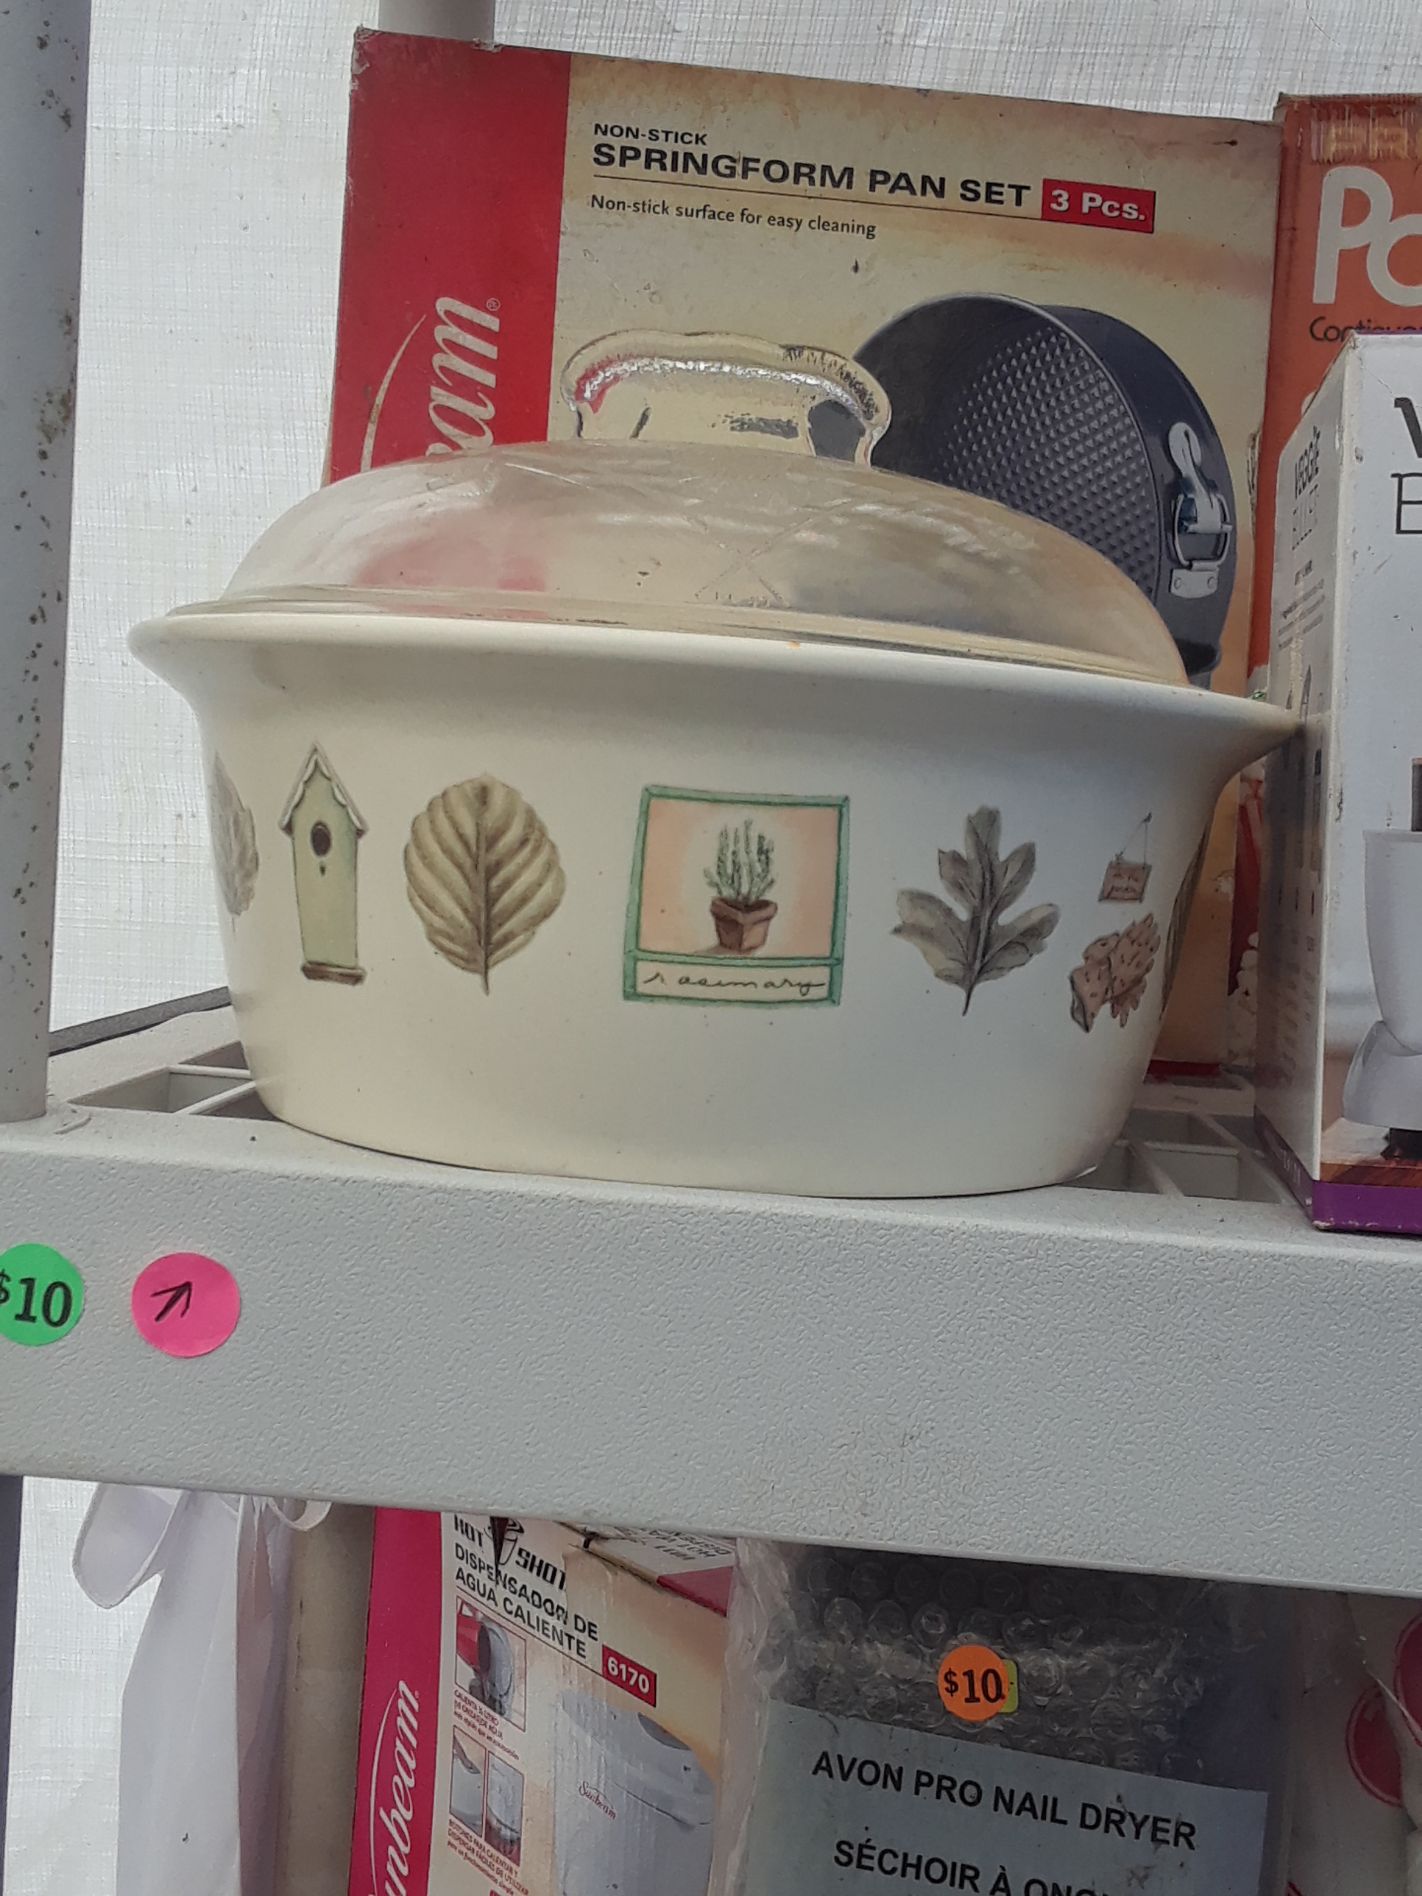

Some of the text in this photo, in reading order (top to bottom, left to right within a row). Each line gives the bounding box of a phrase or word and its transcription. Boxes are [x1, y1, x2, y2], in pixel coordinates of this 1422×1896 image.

[593, 123, 708, 146] NON-STICK
[592, 143, 1031, 207] SPRINGFORM PAN SET
[590, 194, 877, 239] Non-stick surface for easy cleaning
[1050, 189, 1146, 221] 3 Pcs.
[454, 1514, 483, 1547] HOT
[455, 1543, 568, 1625] DISPENSADOR
[574, 1614, 598, 1641] DE
[456, 1567, 587, 1659] AGUA CALIENTE
[607, 1656, 650, 1694] 6170
[943, 1667, 1003, 1703] $10
[812, 1751, 1197, 1850] AVON PRO NAIL DRYER
[834, 1838, 981, 1893] SÉCHOIR
[989, 1865, 1012, 1896] À
